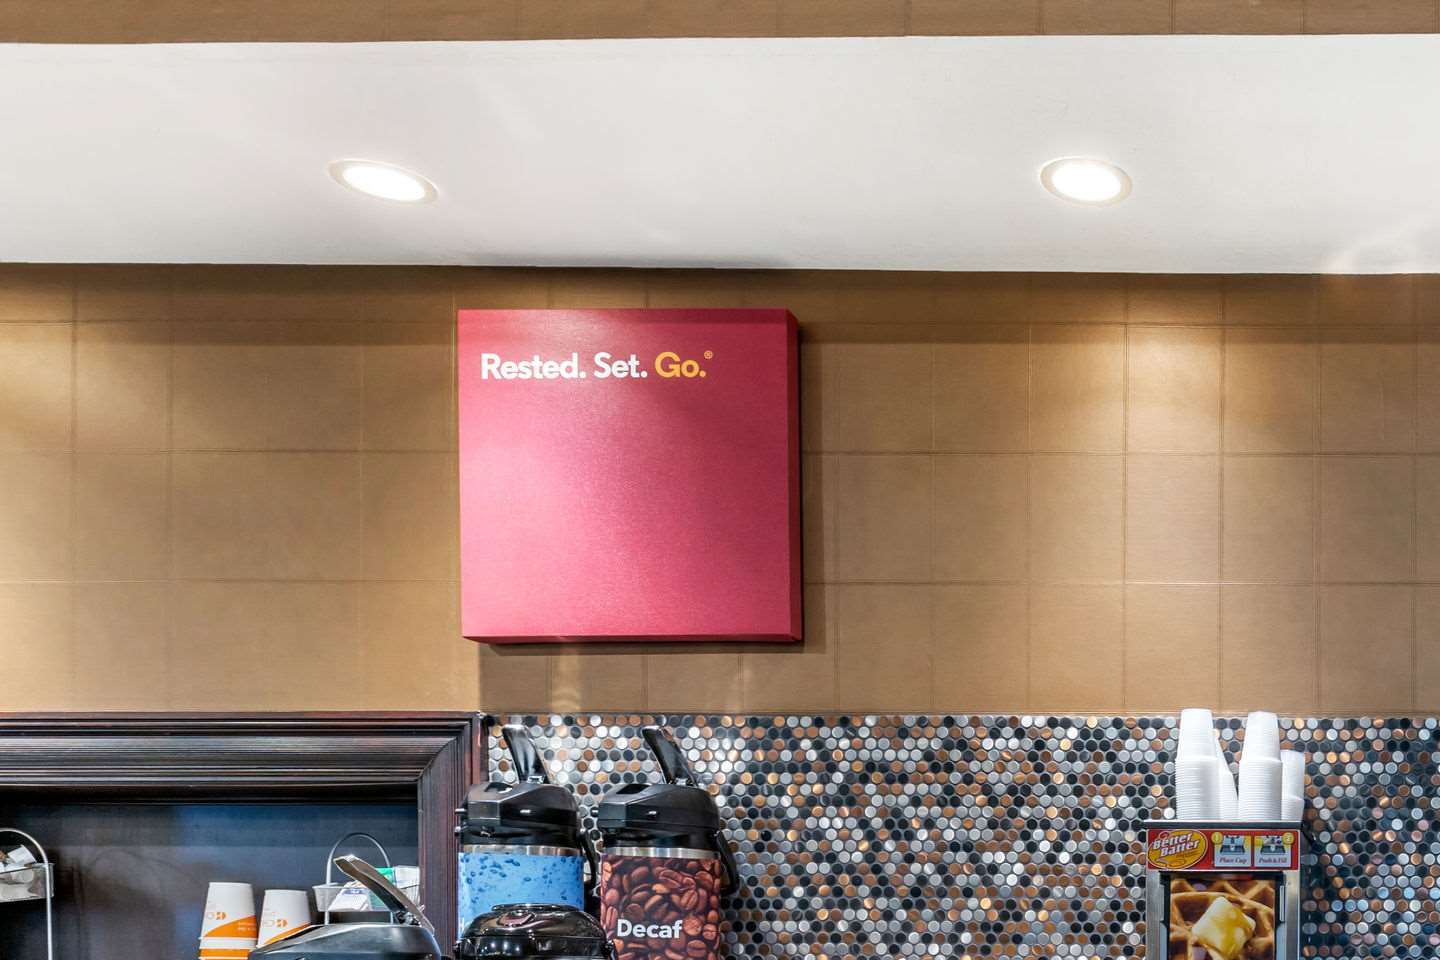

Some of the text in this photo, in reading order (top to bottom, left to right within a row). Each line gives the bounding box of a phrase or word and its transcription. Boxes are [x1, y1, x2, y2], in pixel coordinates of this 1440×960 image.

[481, 352, 587, 380] Rested.
[593, 351, 648, 379] Set.
[1152, 832, 1193, 850] Better
[1160, 840, 1200, 857] Batter
[617, 919, 684, 939] Decaf
